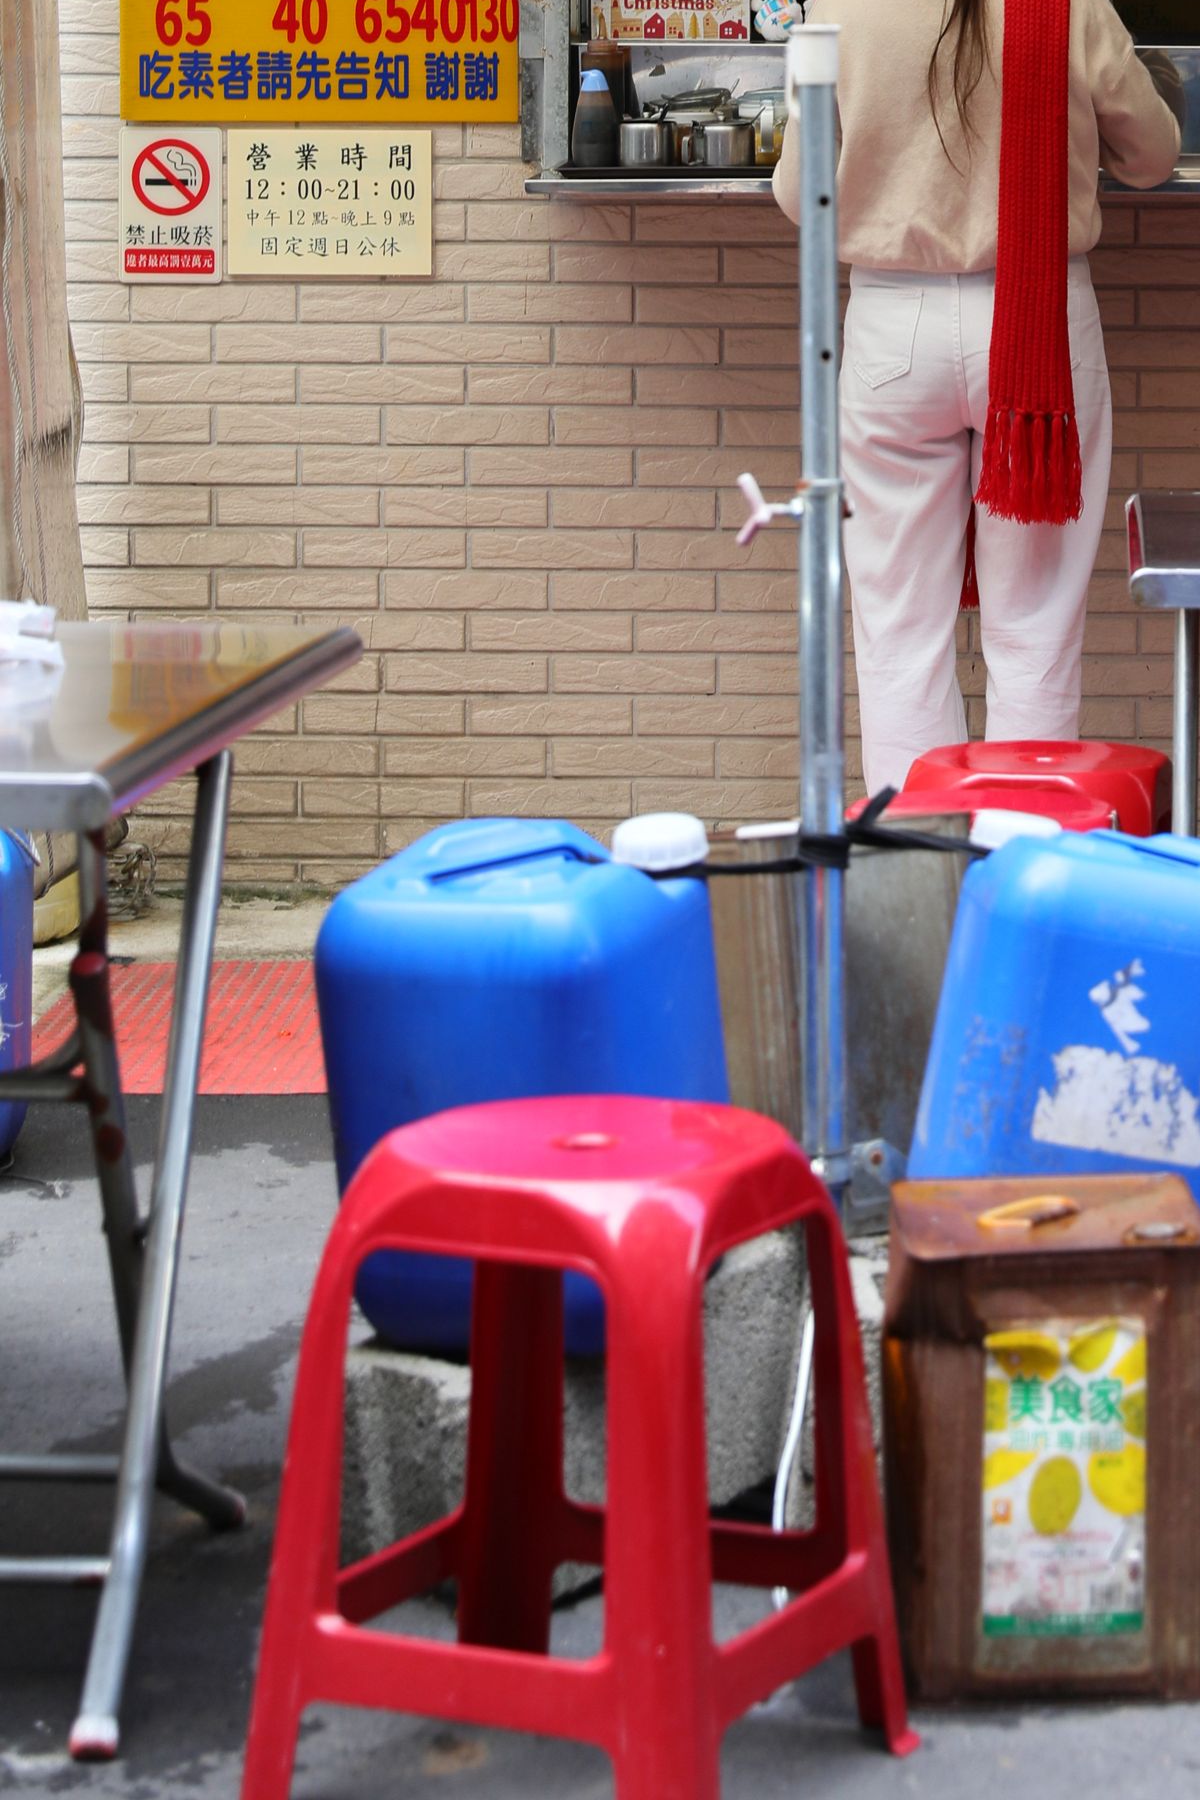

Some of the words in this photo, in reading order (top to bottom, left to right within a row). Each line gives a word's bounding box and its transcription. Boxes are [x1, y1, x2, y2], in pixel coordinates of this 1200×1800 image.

[139, 50, 411, 101] 吃素者請先告知
[425, 50, 499, 101] 謝謝
[246, 142, 412, 171] 營業時間
[126, 225, 213, 246] 禁止吸菸
[261, 236, 402, 257] 固定週日公休
[1008, 1372, 1125, 1427] 美食家
